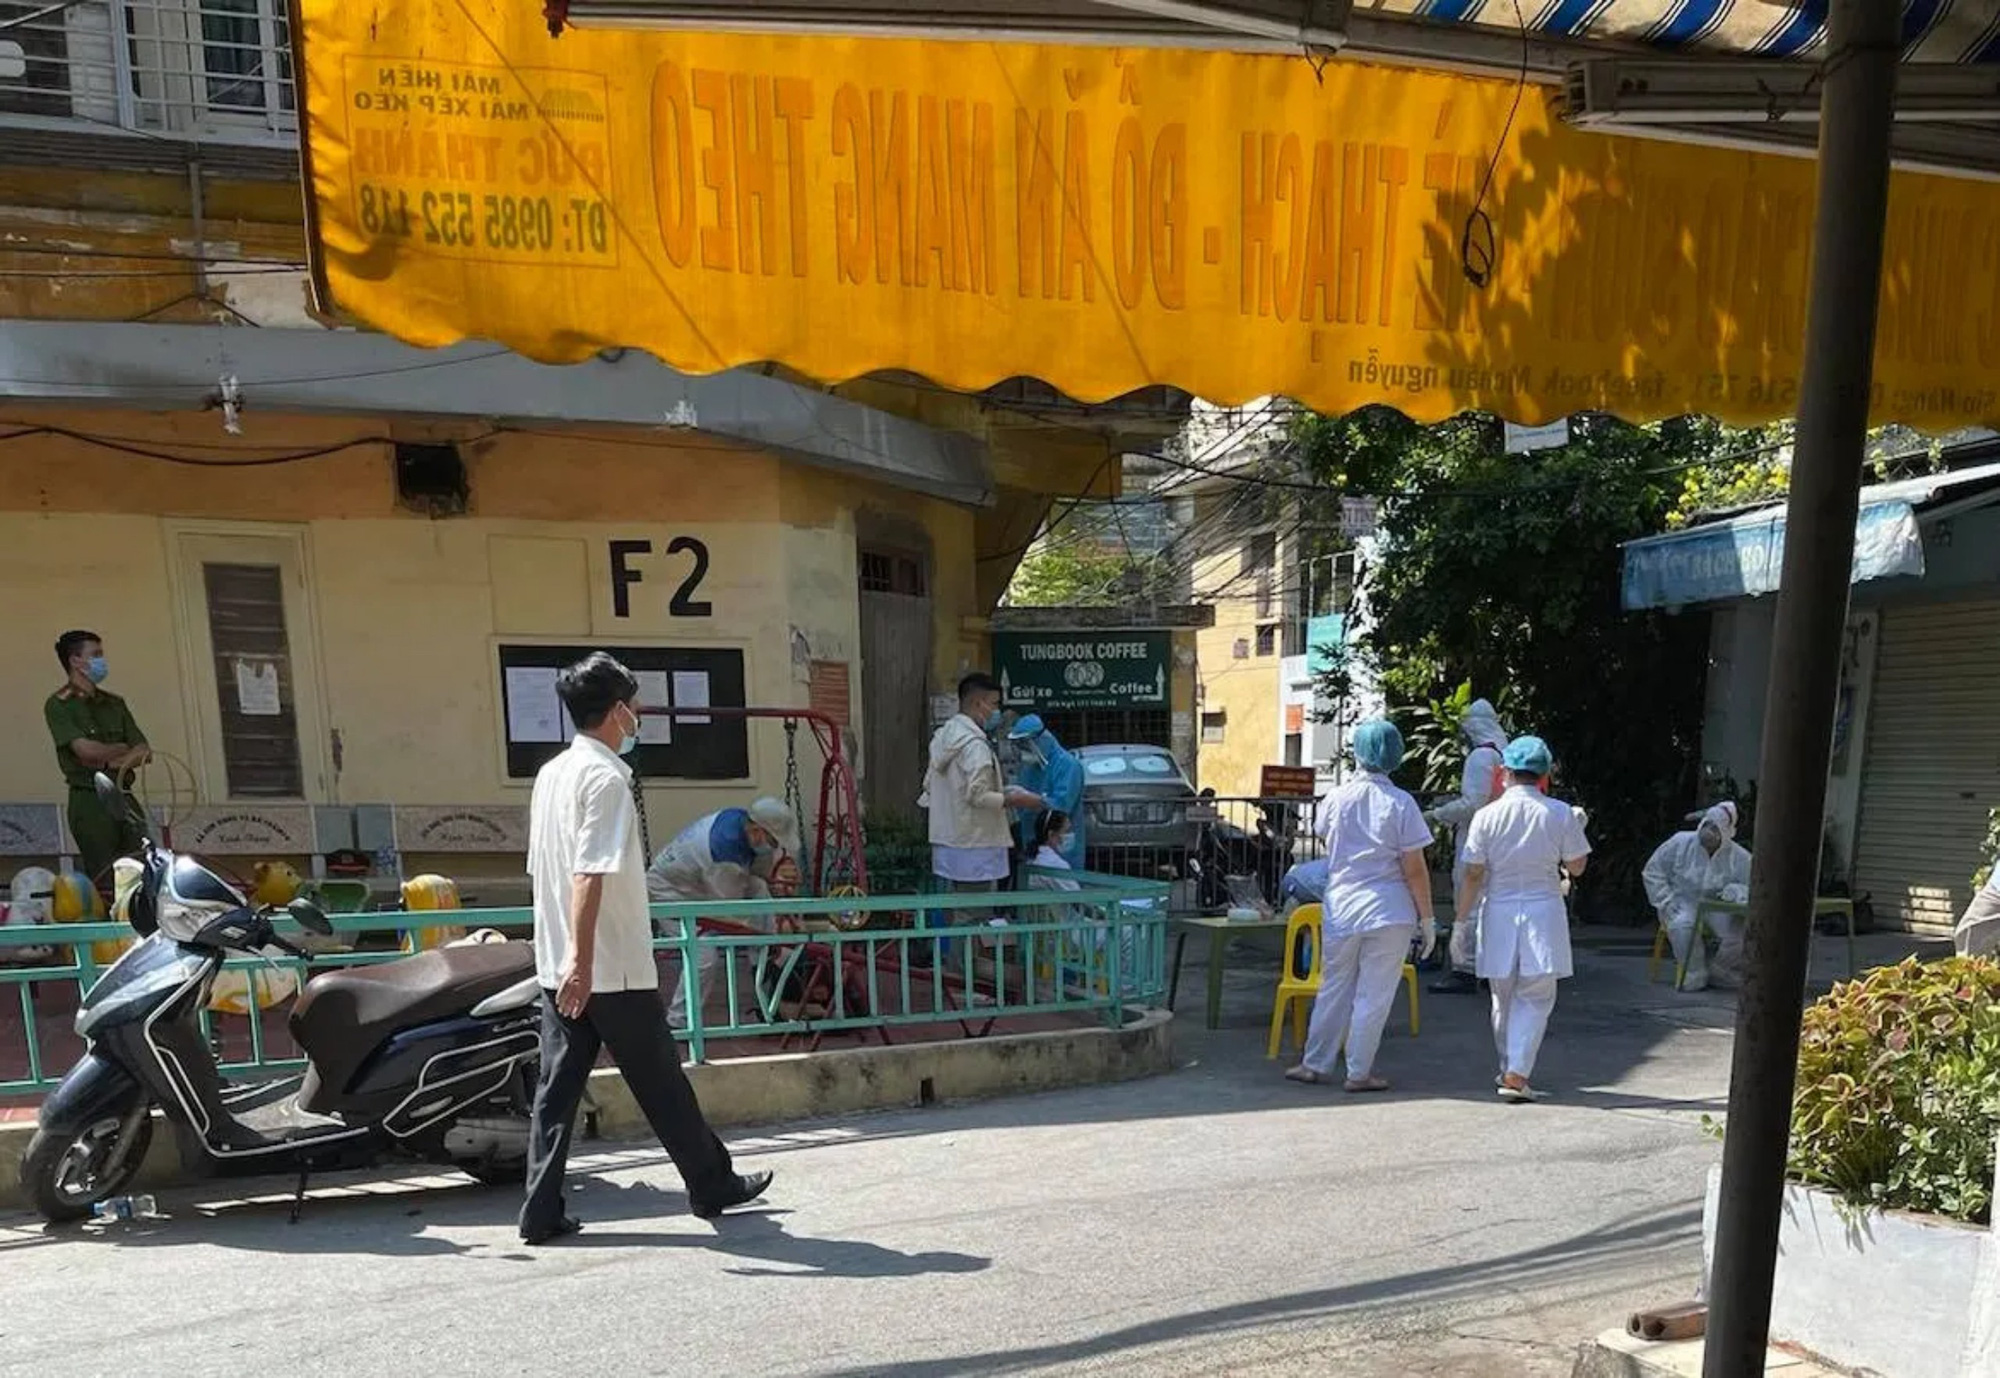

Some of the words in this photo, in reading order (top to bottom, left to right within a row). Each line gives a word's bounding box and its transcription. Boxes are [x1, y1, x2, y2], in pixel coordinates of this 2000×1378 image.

[1020, 643, 1094, 660] TUNGBOOK
[1097, 642, 1147, 659] COFFEE
[1109, 682, 1153, 695] Coffee
